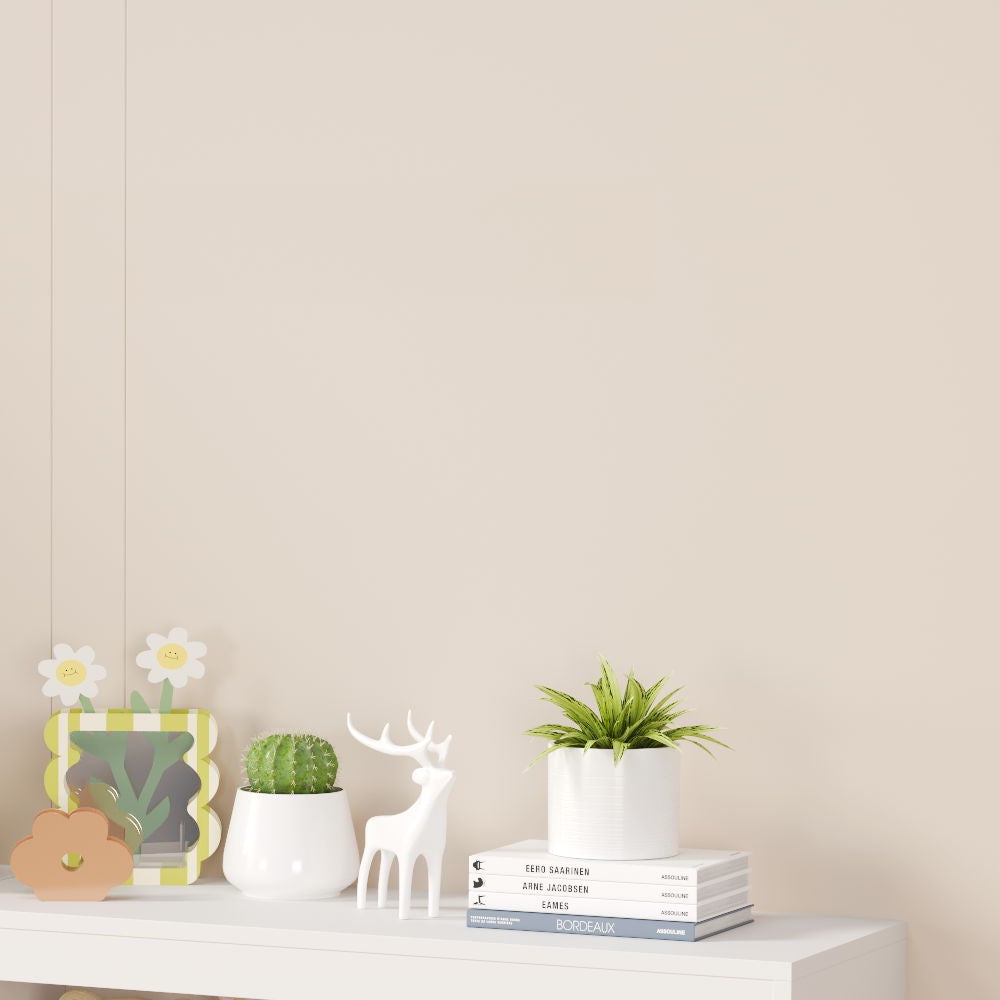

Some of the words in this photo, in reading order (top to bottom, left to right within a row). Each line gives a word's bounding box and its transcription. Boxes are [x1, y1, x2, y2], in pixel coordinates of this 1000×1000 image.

[525, 864, 546, 873] EERO
[549, 866, 590, 876] SAARINEN
[522, 882, 544, 891] ARNE
[547, 884, 589, 893] JACOBSEN
[541, 900, 569, 910] EAMES
[556, 919, 616, 934] BORDEAUX
[656, 928, 686, 936] ASSOULINE
